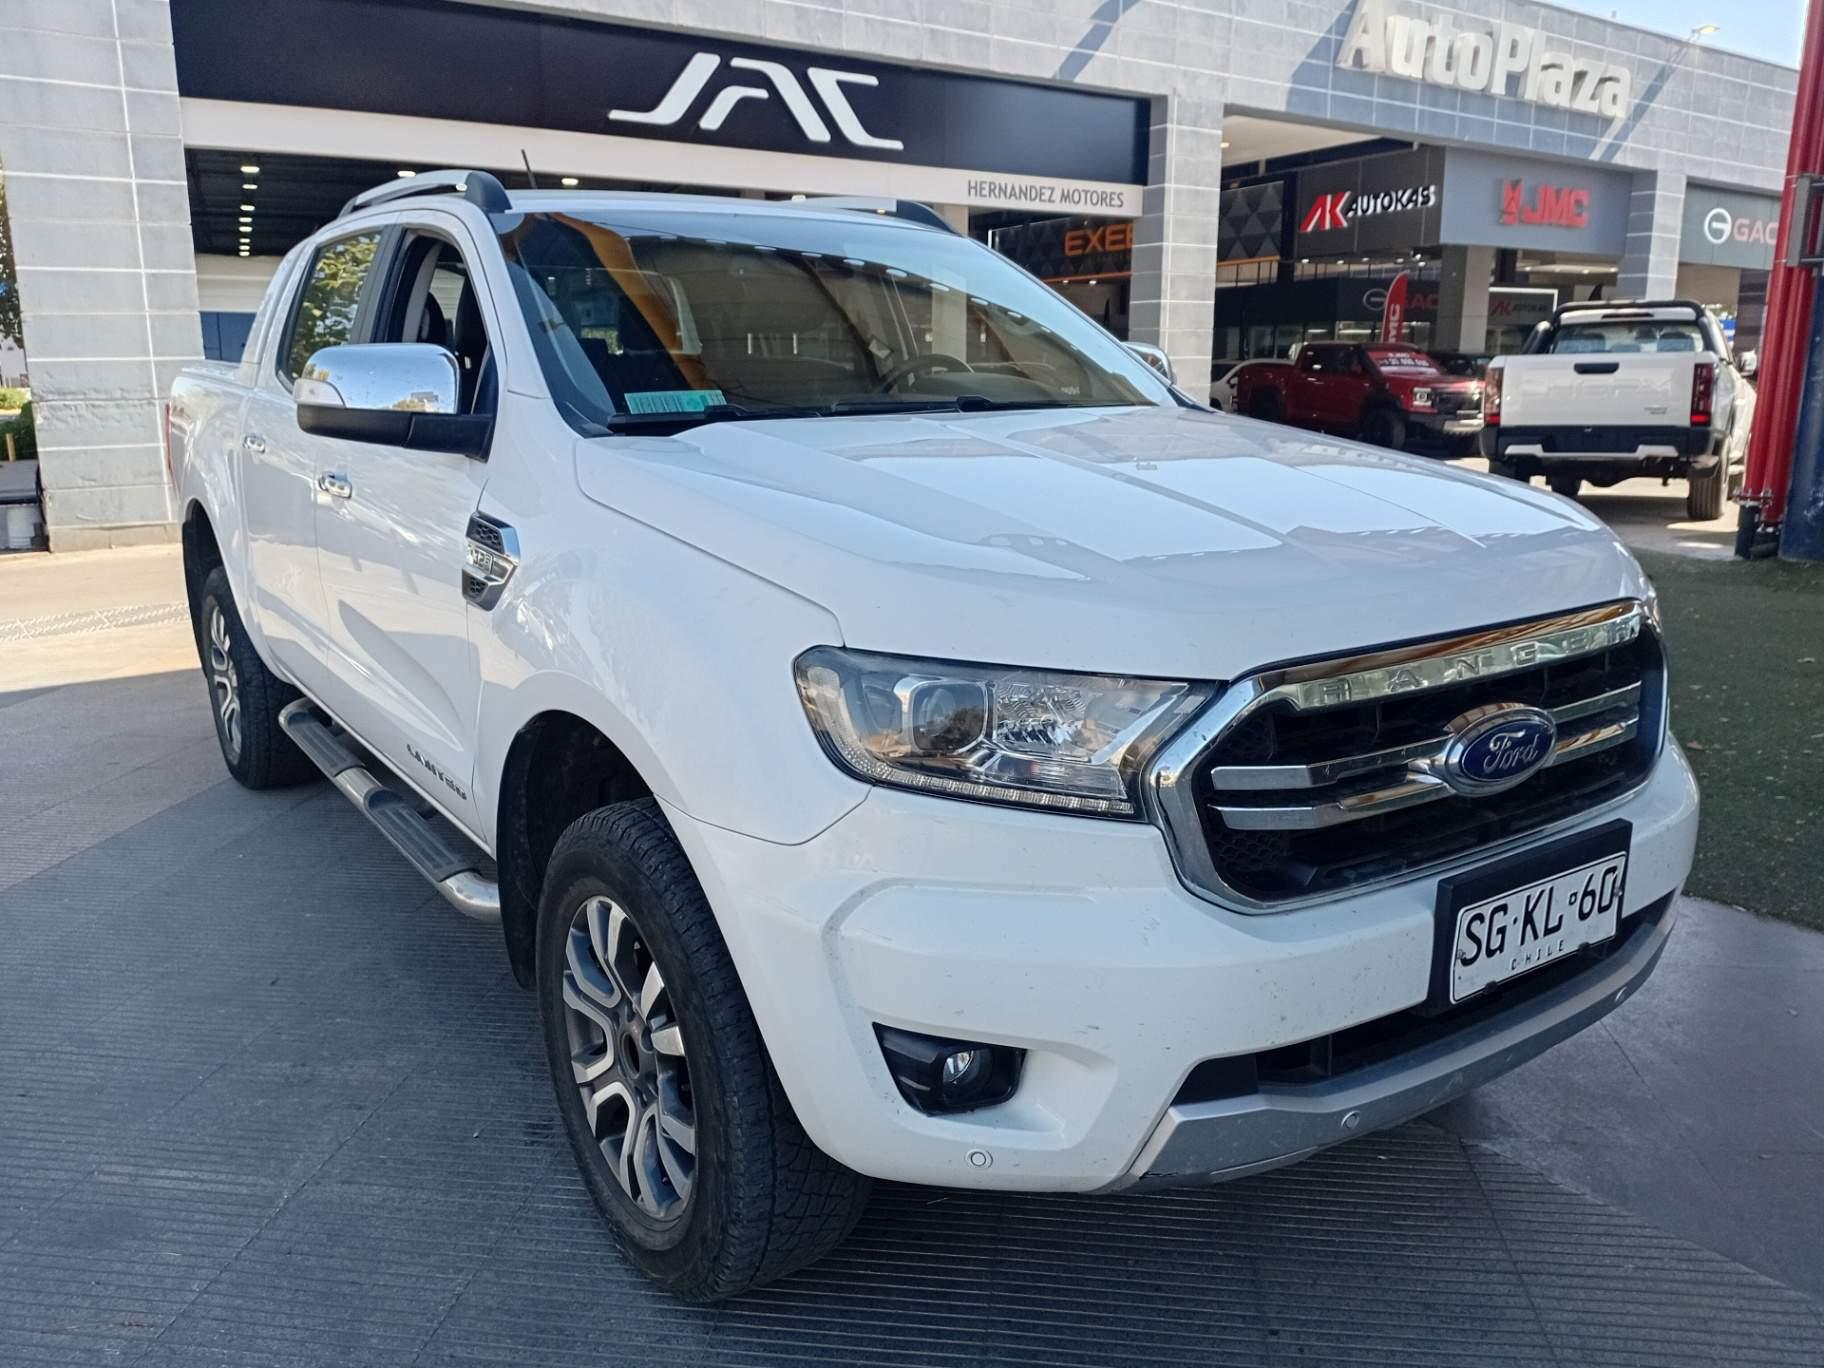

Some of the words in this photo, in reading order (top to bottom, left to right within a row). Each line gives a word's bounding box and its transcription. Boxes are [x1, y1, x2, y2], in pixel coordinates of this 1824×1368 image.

[1335, 0, 1631, 118] AutoPlaza
[608, 52, 904, 149] JAC
[967, 179, 1056, 203] HERNANDEZ
[1060, 187, 1124, 208] MOTORES
[1524, 184, 1589, 226] JMC
[1733, 217, 1779, 246] GAC
[1483, 729, 1539, 774] Ford
[1511, 939, 1564, 970] CHILE
